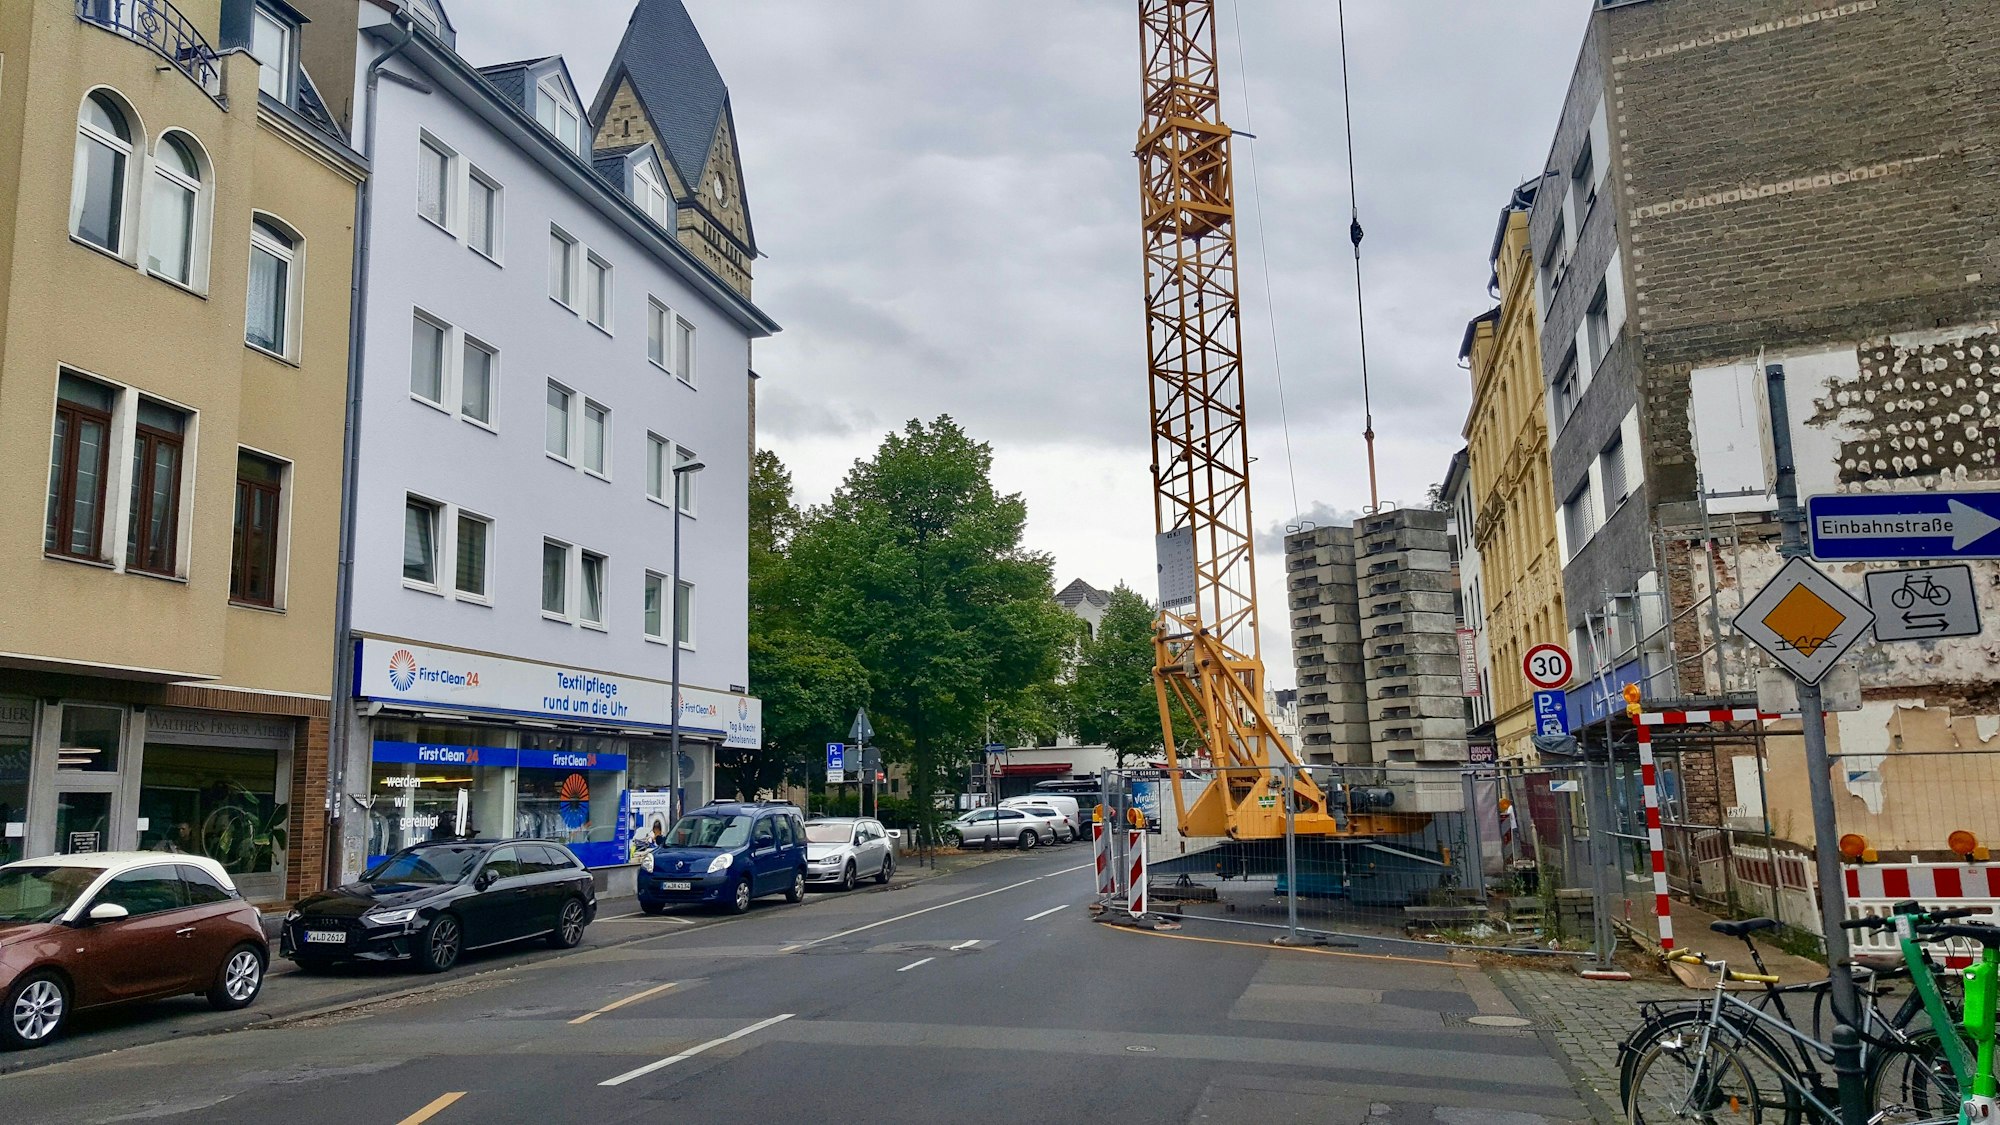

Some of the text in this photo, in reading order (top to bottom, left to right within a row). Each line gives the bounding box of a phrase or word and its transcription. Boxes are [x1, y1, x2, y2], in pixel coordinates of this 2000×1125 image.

[1822, 518, 1954, 534] Einbahnstraße
[1162, 595, 1192, 609] LIEBHERR
[1463, 633, 1478, 691] WERBETECHNIK
[1533, 656, 1562, 677] 30
[557, 672, 617, 698] Textilpflege
[543, 695, 628, 717] rund um die Uhr
[1538, 694, 1553, 714] P
[729, 721, 756, 732] Tag & Nacht
[728, 734, 756, 744] Abholservice
[829, 744, 837, 756] P
[1470, 746, 1492, 754] DRUCK
[1470, 753, 1492, 761] COPY
[386, 774, 420, 788] werden
[394, 794, 409, 808] wir
[1134, 790, 1159, 804] Vivaldi
[400, 814, 440, 830] gereinigt
[407, 834, 425, 847] und
[326, 933, 345, 942] 2612
